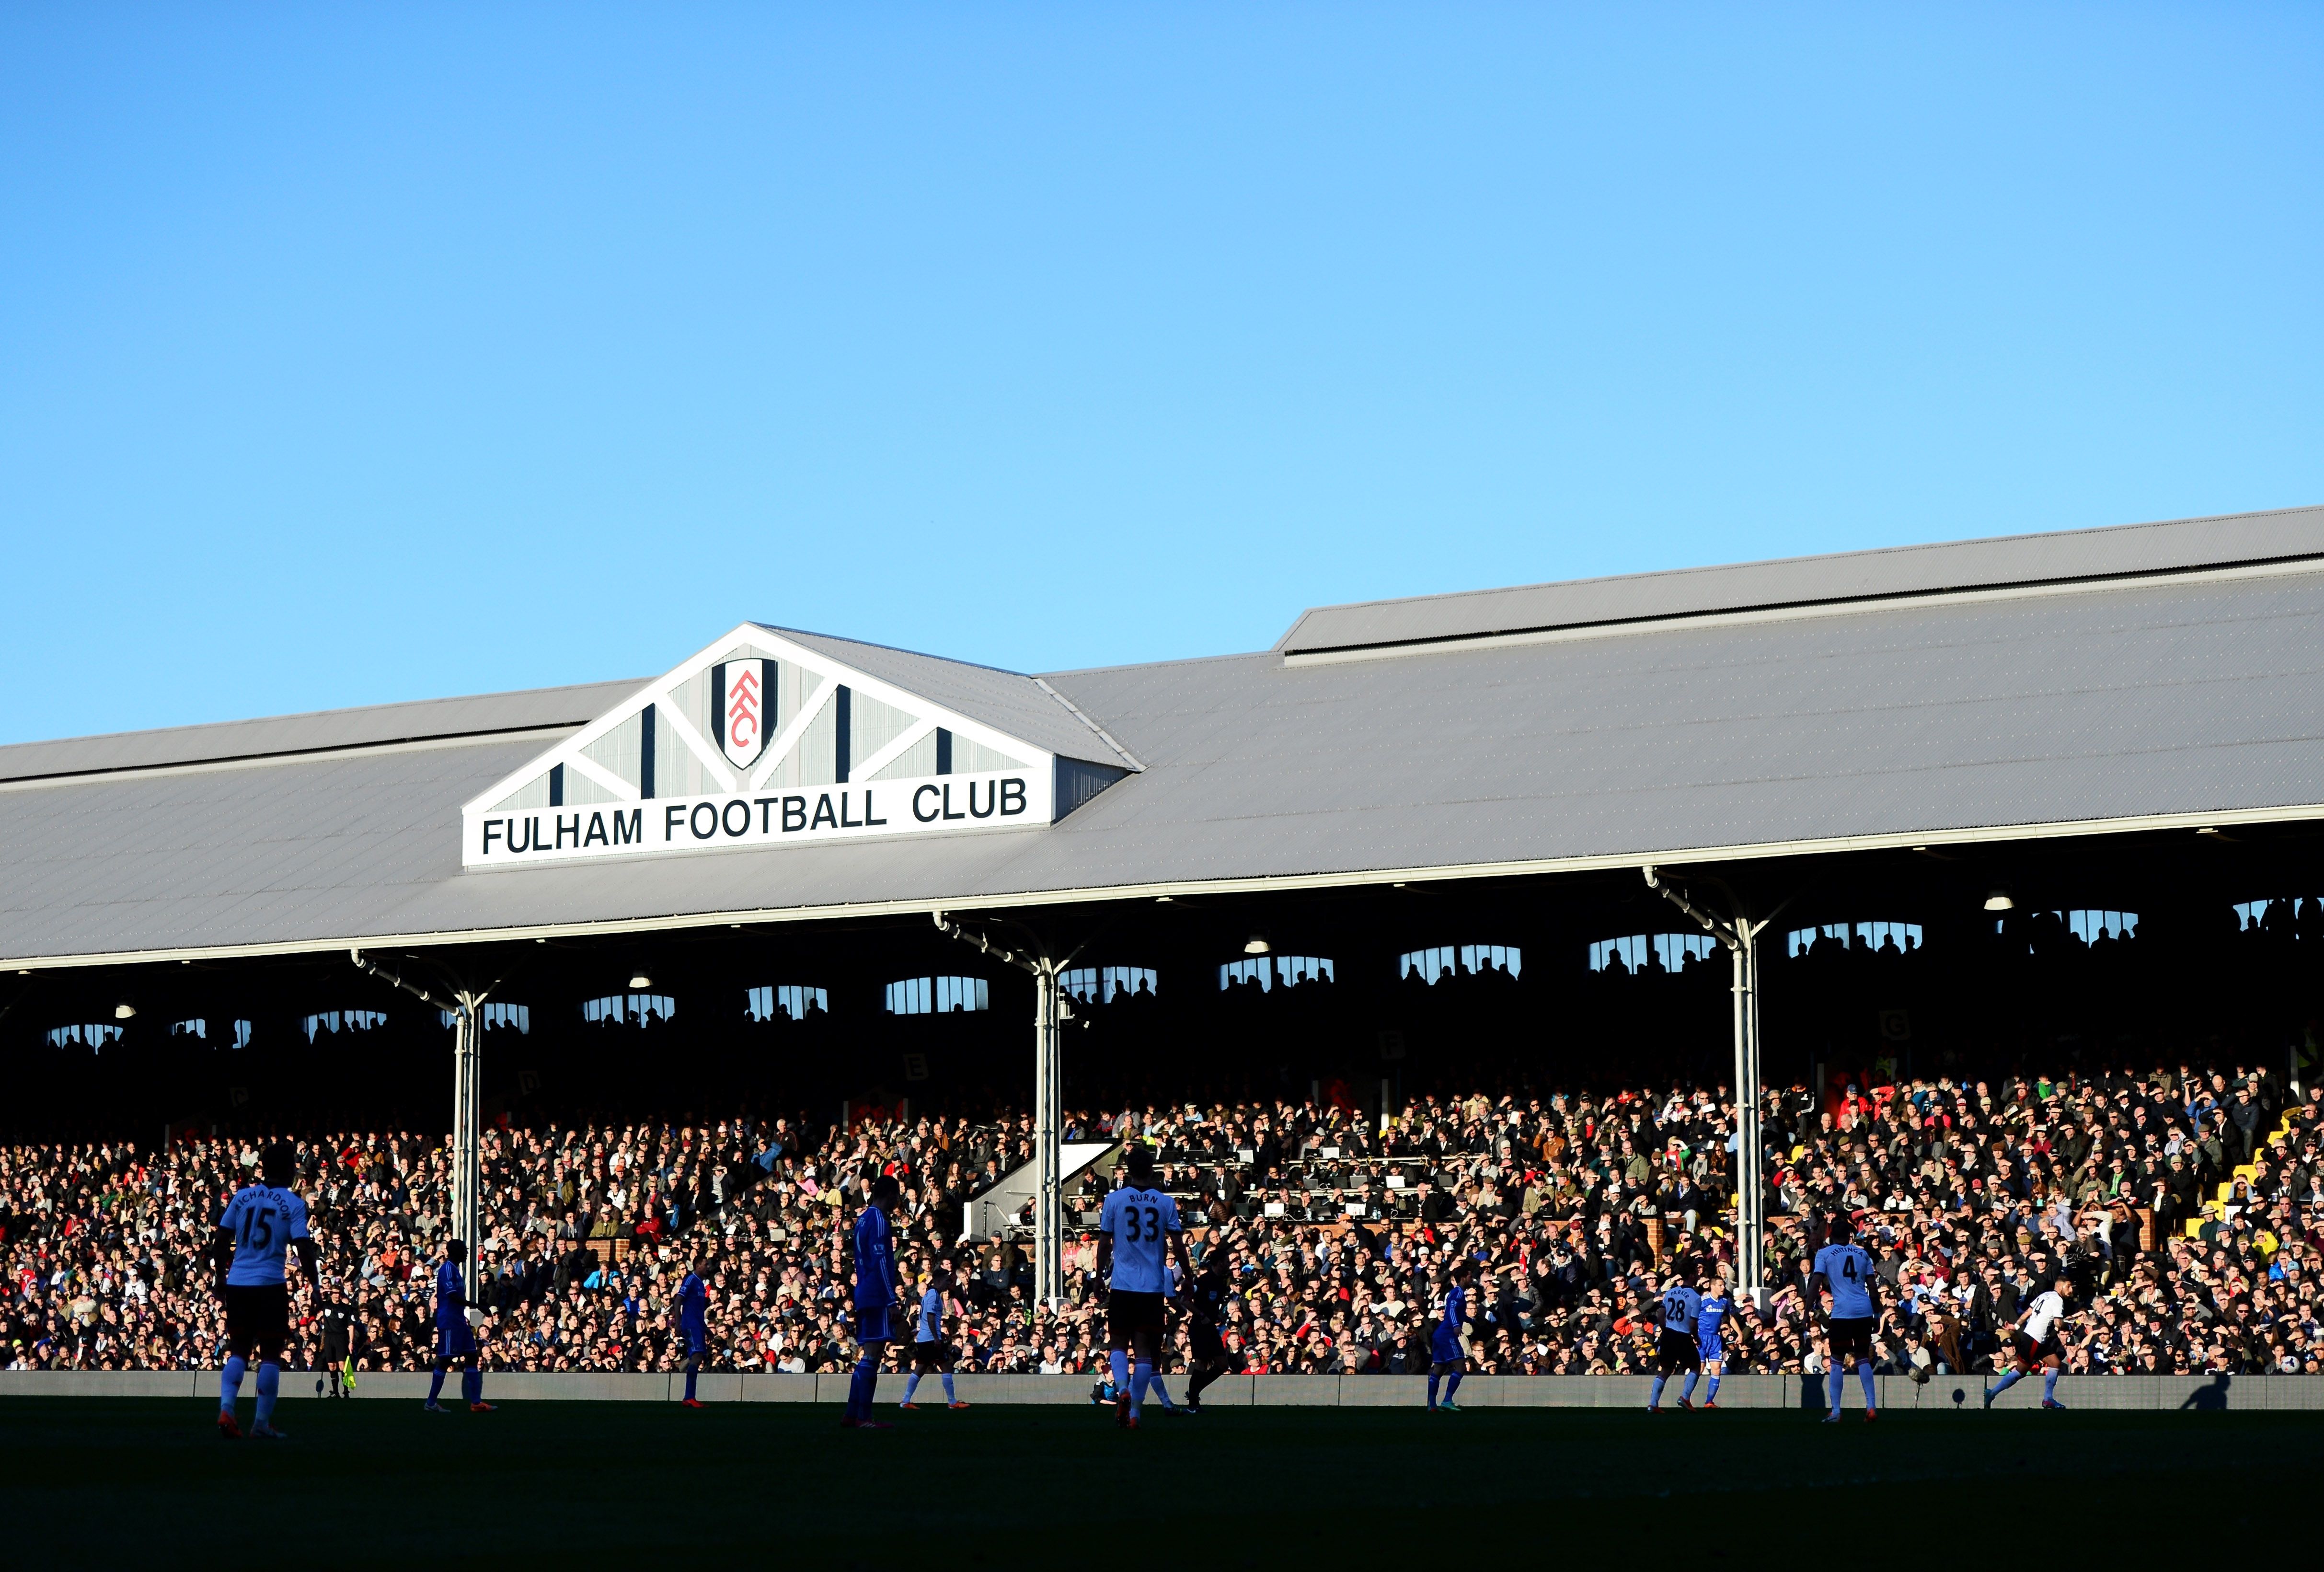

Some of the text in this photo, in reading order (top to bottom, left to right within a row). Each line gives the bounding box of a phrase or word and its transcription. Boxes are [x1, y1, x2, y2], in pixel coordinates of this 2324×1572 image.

[729, 670, 759, 748] FFC
[483, 777, 1027, 855] FULHAM FOOTBALL CLUB
[908, 1057, 923, 1076] E
[235, 1190, 290, 1220] RICHARDSON
[1129, 1193, 1158, 1204] BURN
[242, 1206, 276, 1250] 15
[1125, 1206, 1159, 1243] 33
[1830, 1247, 1863, 1257] HEITINGA
[1842, 1255, 1858, 1284] 4
[1670, 1289, 1690, 1299] PARKER
[2032, 1297, 2045, 1317] 14
[1667, 1297, 1686, 1322] 28
